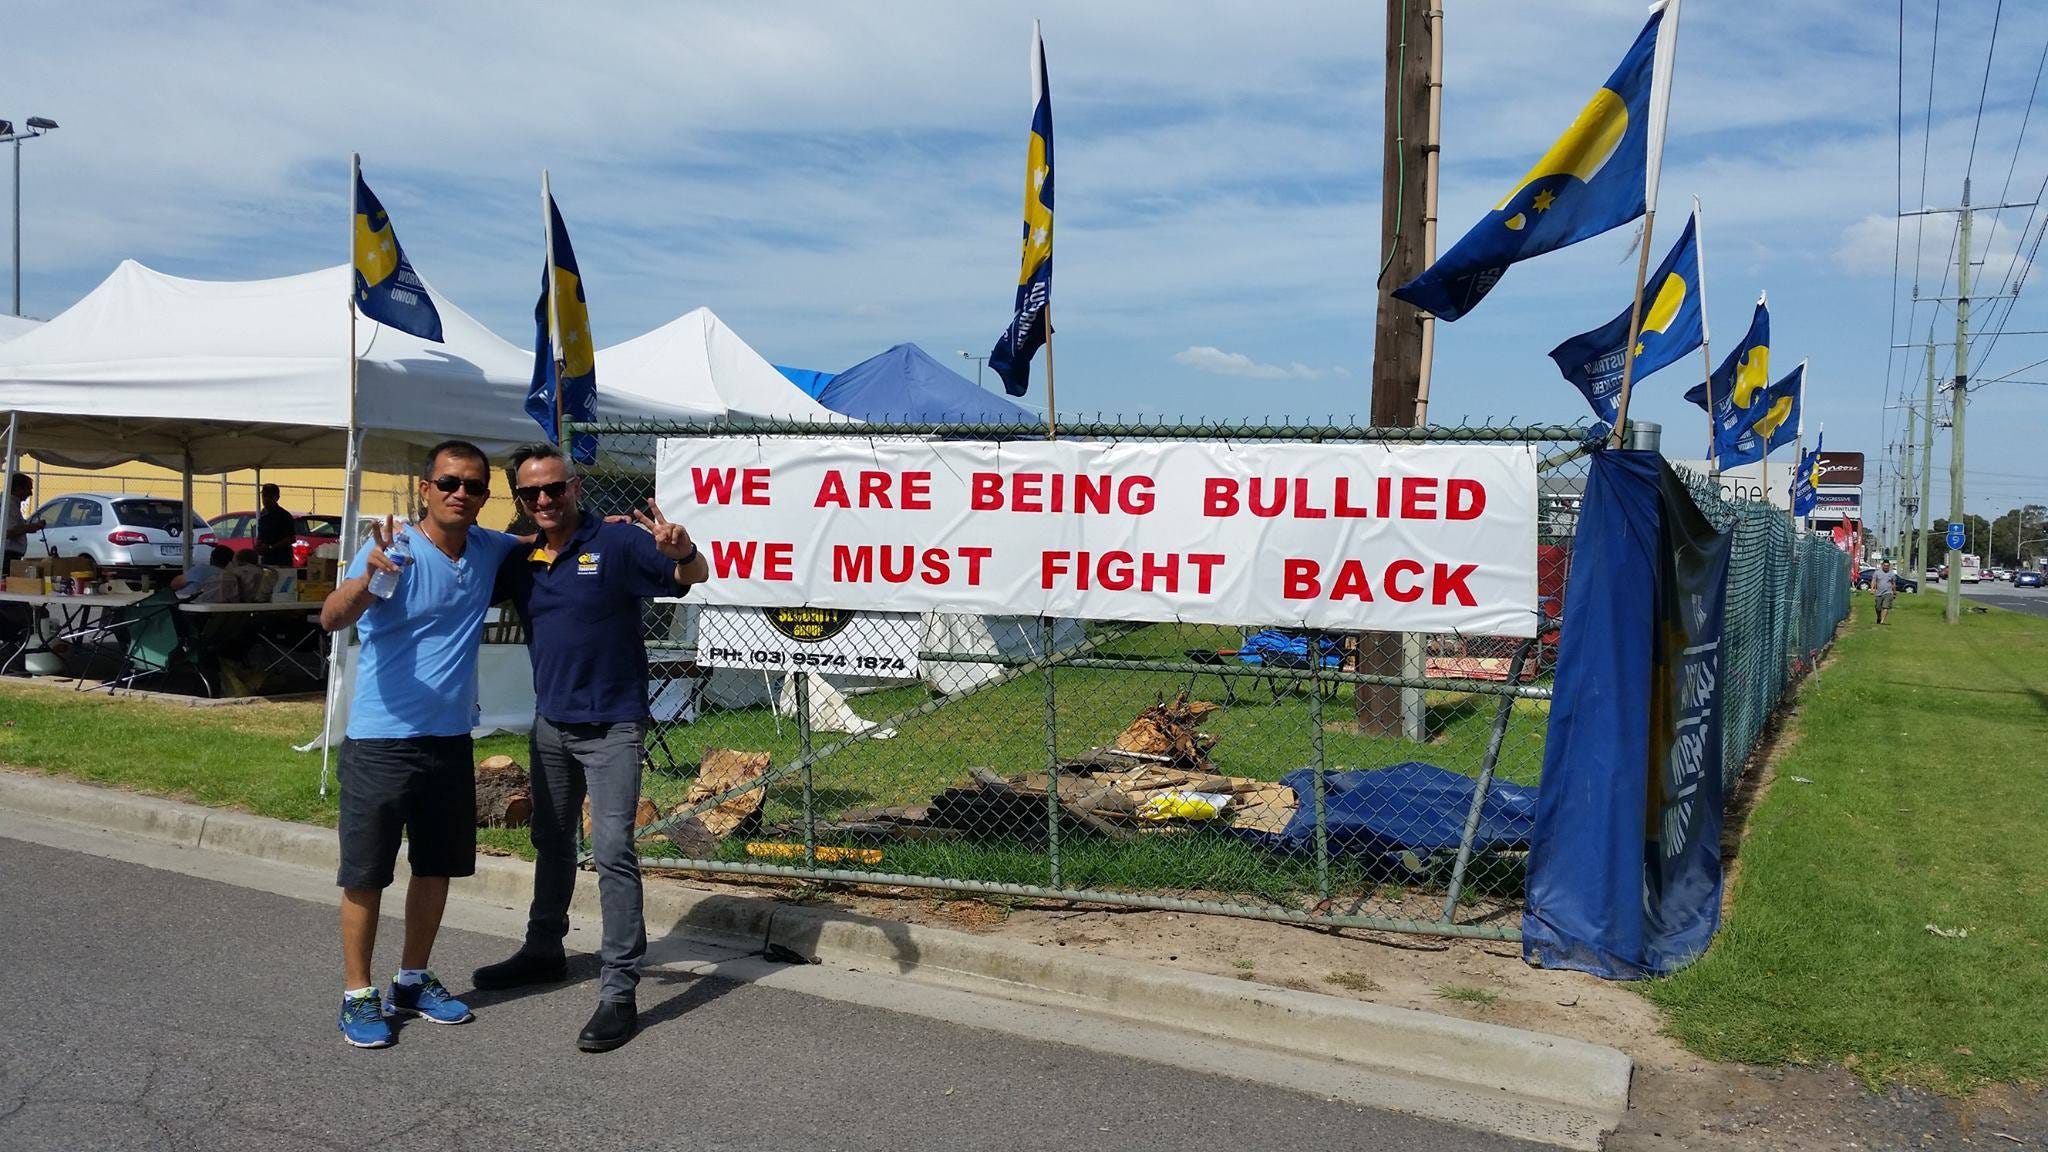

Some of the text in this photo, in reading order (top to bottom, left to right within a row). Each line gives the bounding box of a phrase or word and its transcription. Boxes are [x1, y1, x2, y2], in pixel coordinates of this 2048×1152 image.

[391, 287, 418, 306] UNION
[691, 467, 1487, 521] WE ARE BEING BULLIED
[1952, 535, 1960, 545] 9
[711, 540, 1477, 607] WE MUST FIGHT BACK
[793, 624, 824, 637] GROUP
[709, 648, 906, 671] PH: (03) 9574 1874
